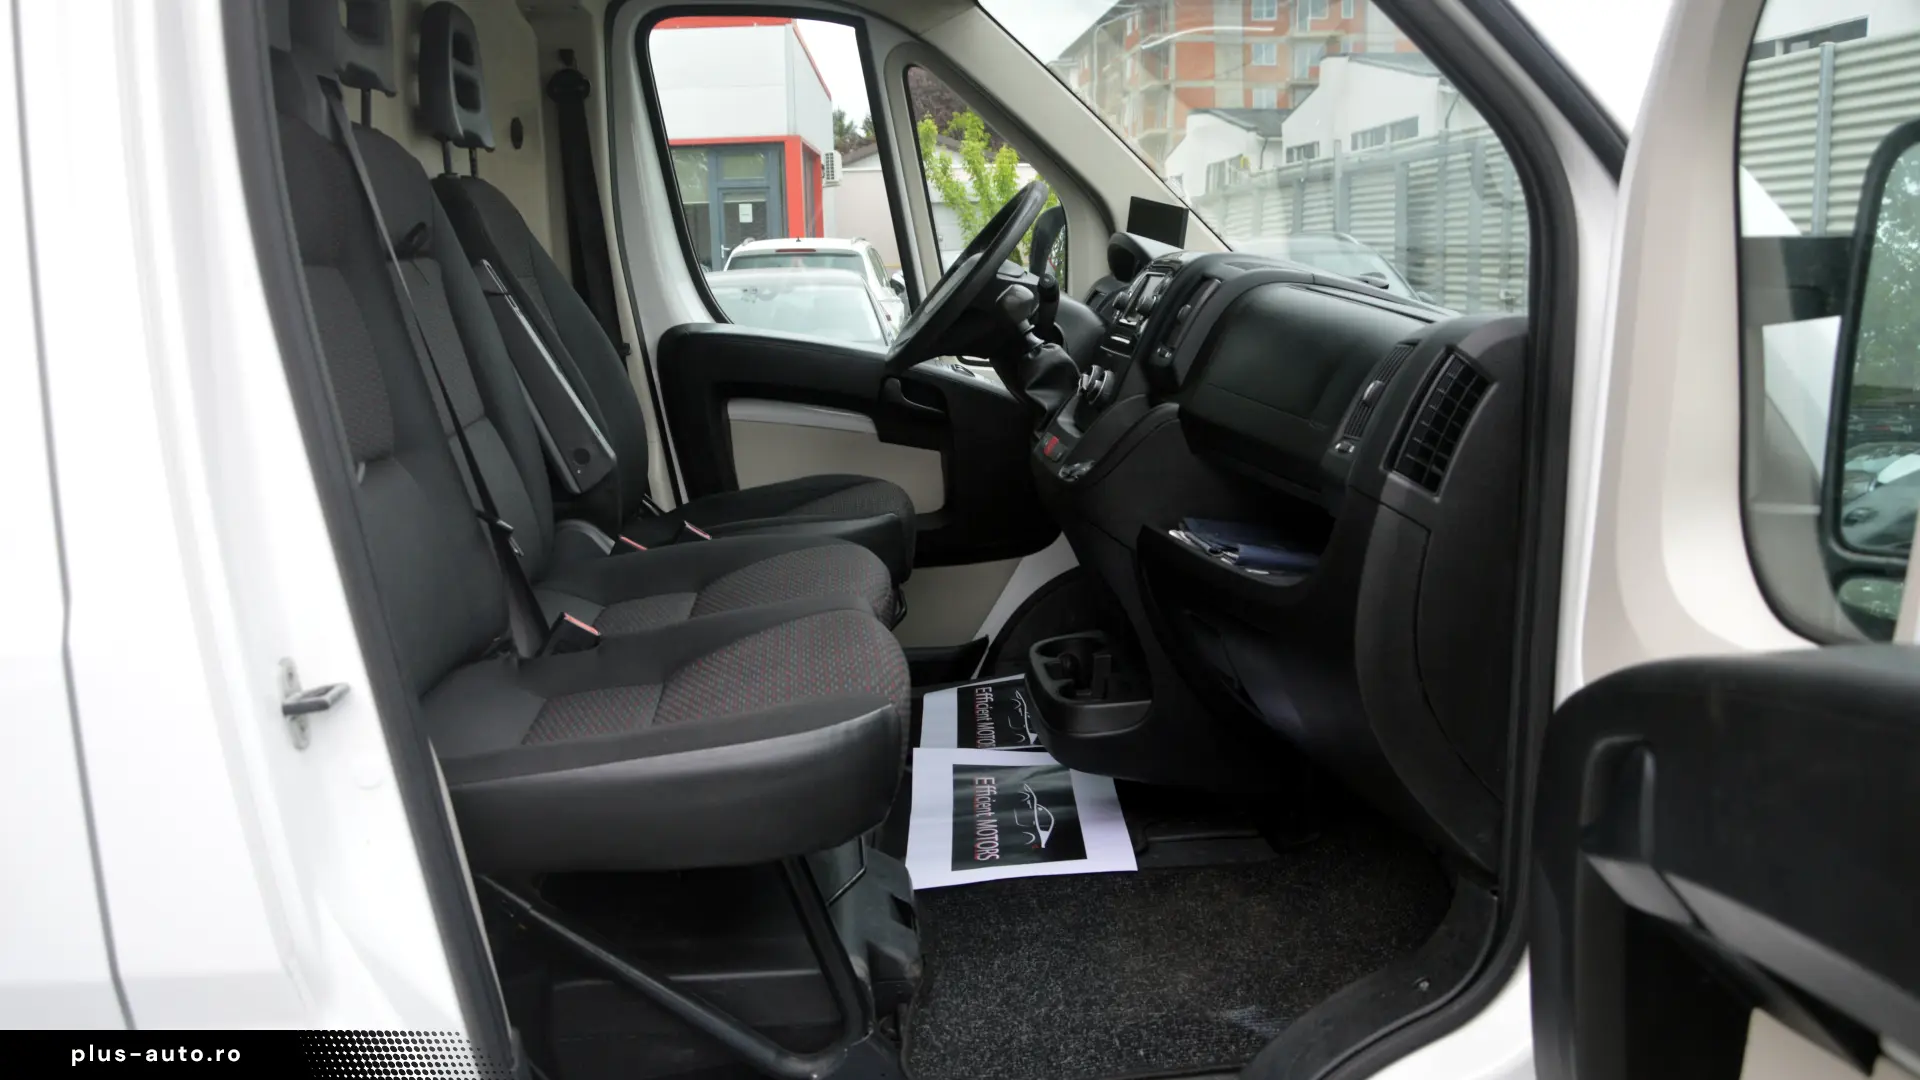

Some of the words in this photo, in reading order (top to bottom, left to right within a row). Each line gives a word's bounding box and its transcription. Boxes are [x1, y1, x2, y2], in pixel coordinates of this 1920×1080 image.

[975, 686, 994, 721] Efficient
[975, 777, 997, 817] Efficient
[975, 819, 1000, 861] MOTORS
